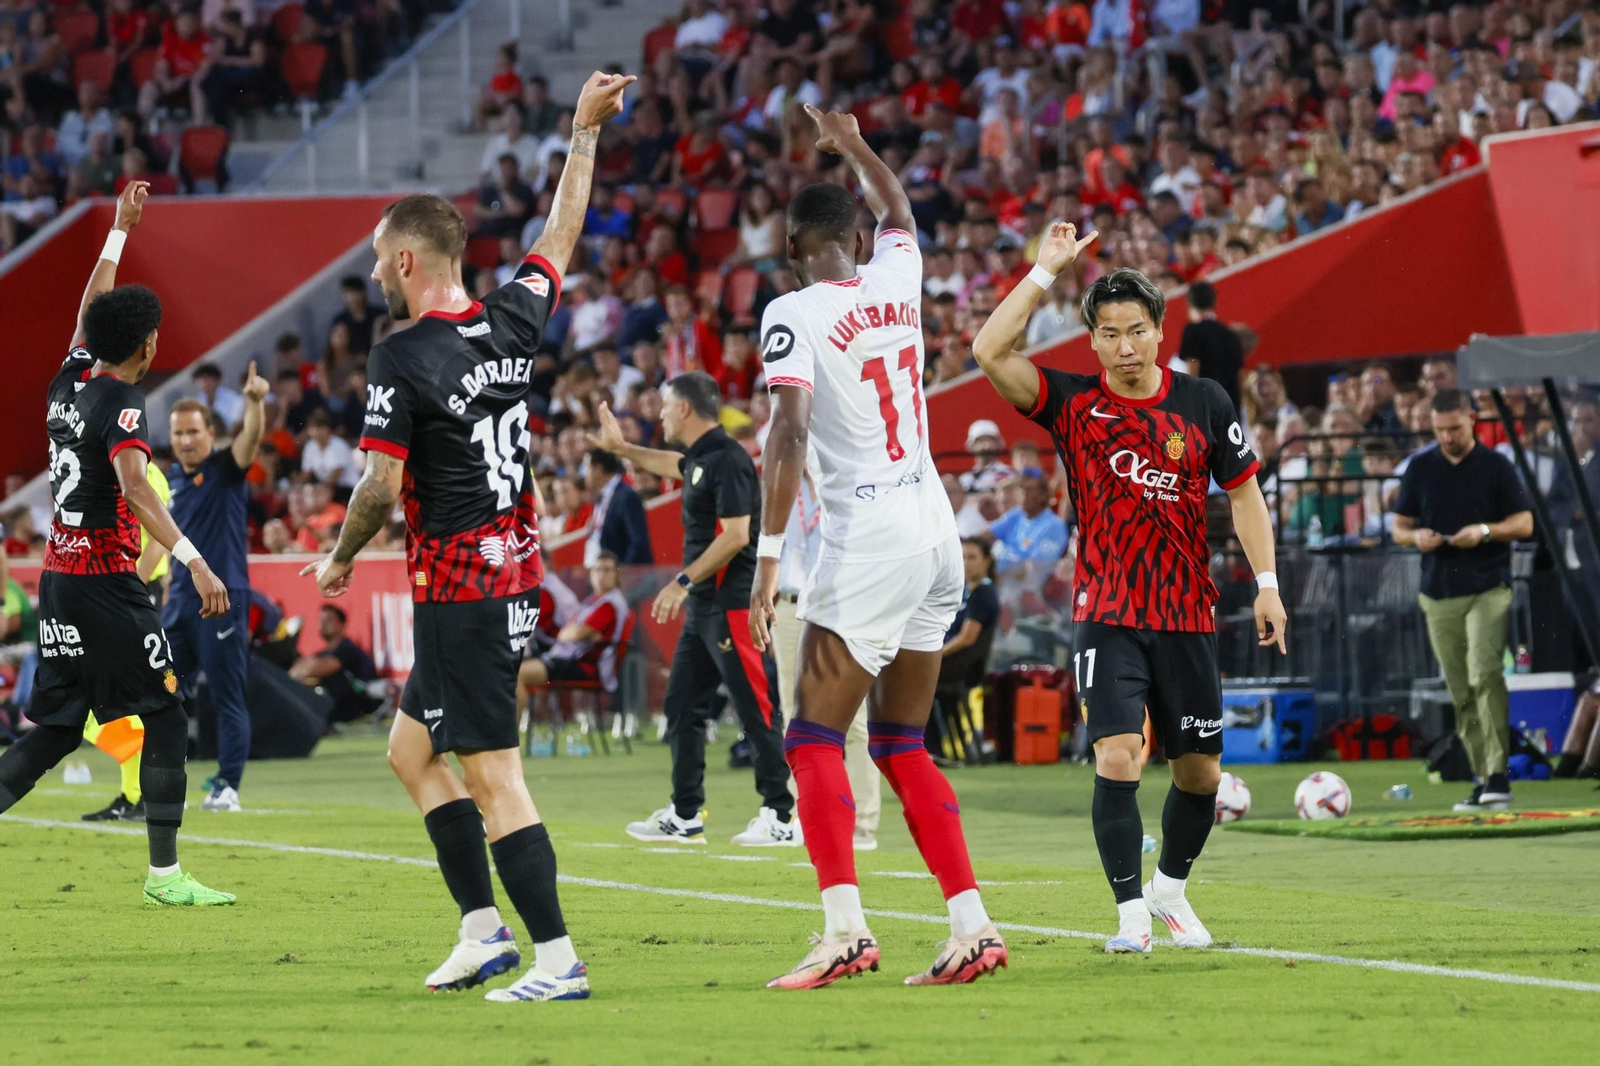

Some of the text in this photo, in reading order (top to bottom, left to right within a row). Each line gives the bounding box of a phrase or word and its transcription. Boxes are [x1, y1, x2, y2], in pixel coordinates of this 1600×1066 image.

[762, 331, 791, 354] JD
[860, 343, 923, 463] 11
[470, 399, 532, 511] 10
[1143, 487, 1180, 503] by Taica
[143, 627, 173, 670] 2
[1073, 648, 1097, 694] 11
